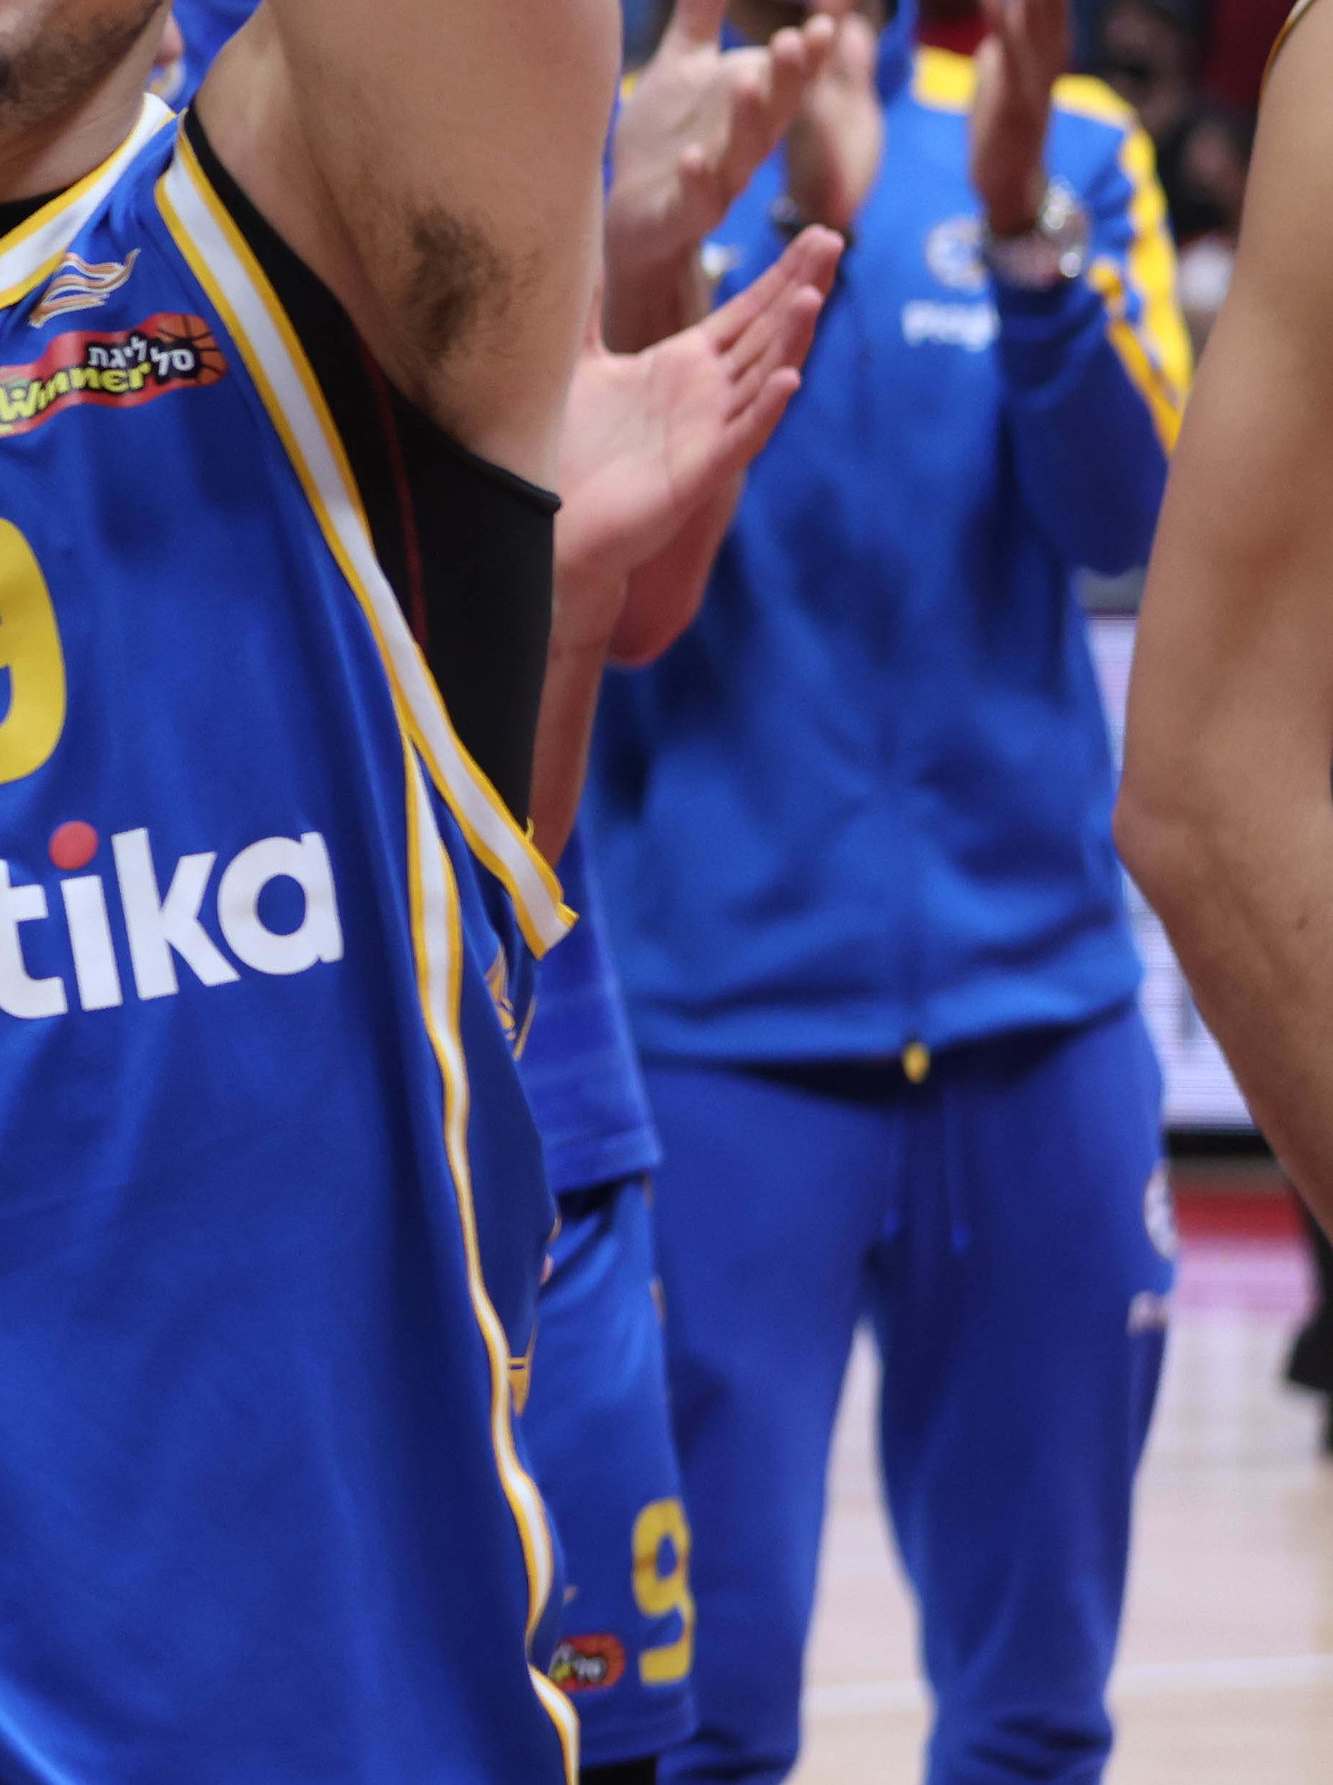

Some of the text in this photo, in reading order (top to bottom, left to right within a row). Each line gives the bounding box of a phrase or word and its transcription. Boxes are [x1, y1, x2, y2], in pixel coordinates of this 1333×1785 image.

[87, 335, 147, 368] ליגת
[150, 346, 195, 376] סל
[633, 1498, 695, 1685] 9
